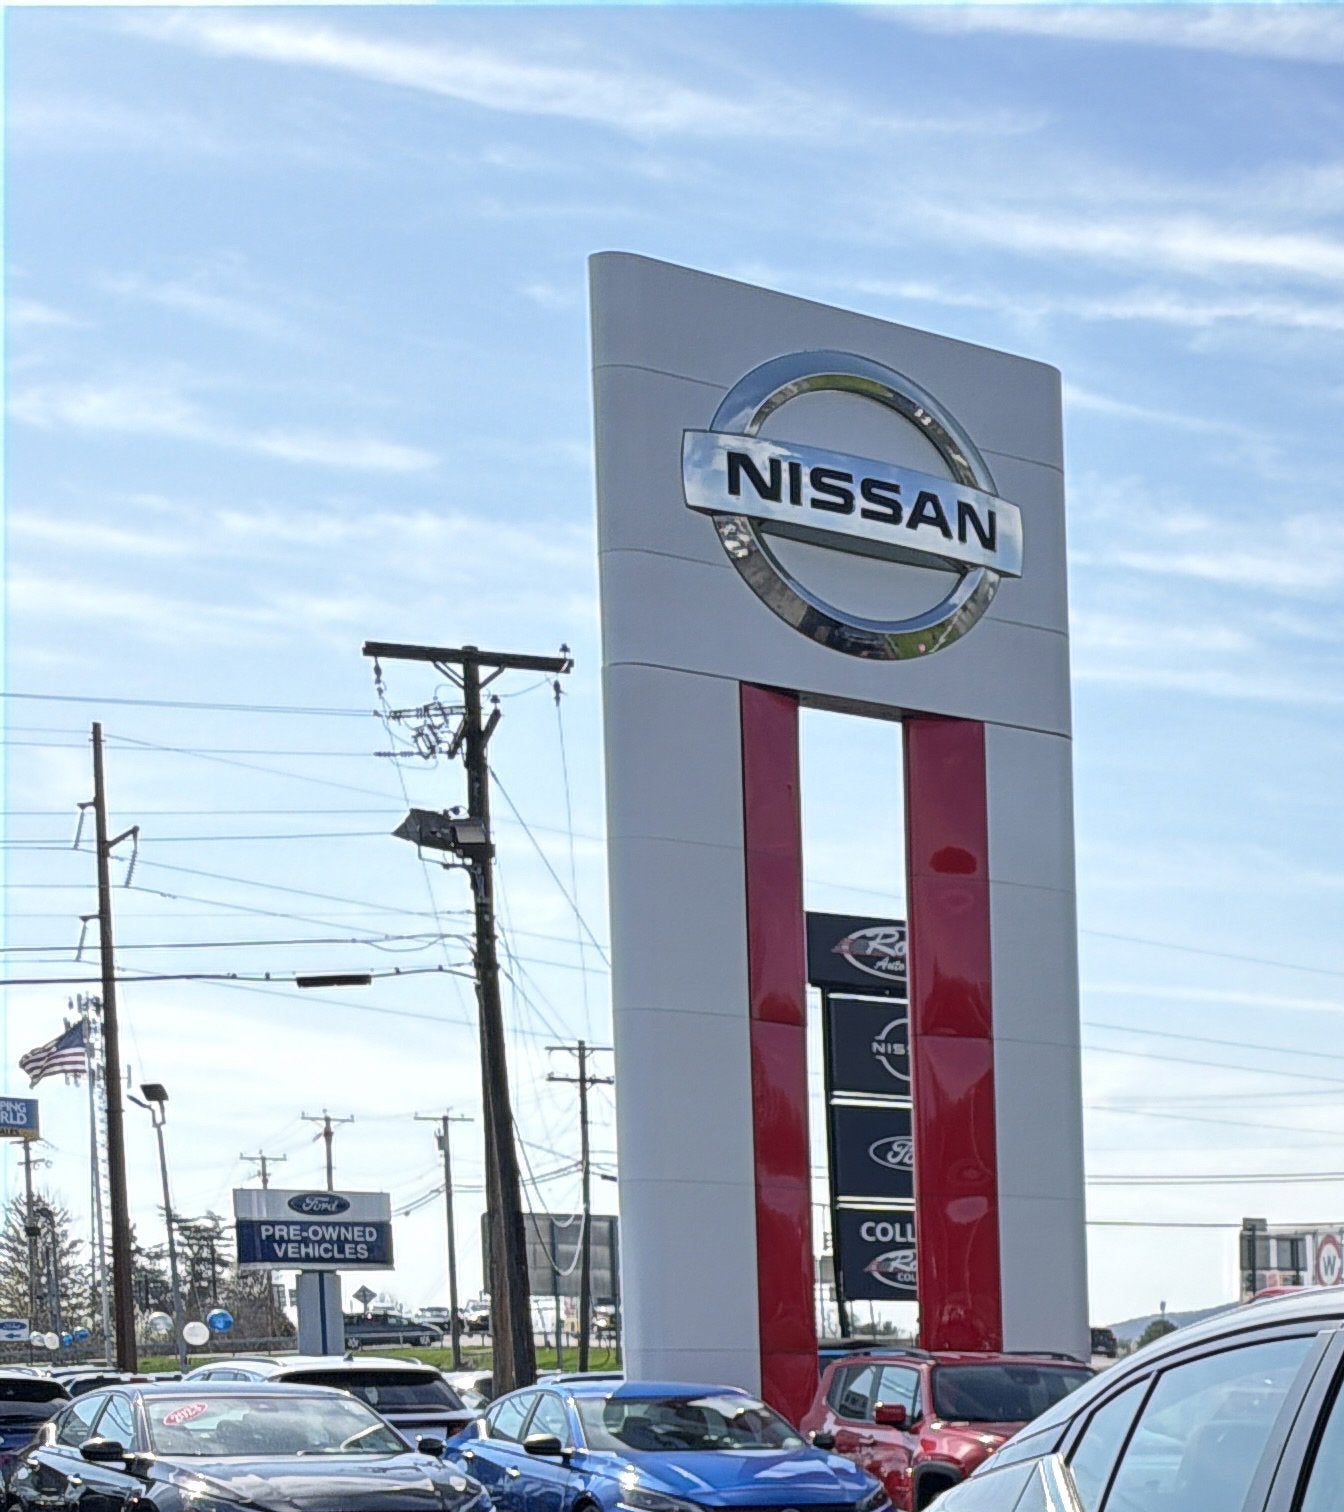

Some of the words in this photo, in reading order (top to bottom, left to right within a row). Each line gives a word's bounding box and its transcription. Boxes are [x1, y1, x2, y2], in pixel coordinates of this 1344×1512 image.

[726, 451, 997, 553] NISSAN
[872, 1041, 911, 1055] NIS
[302, 1196, 338, 1211] Ford
[260, 1225, 378, 1242] PRE-OWNED
[273, 1243, 369, 1259] VEHICLES
[1322, 1255, 1337, 1277] W
